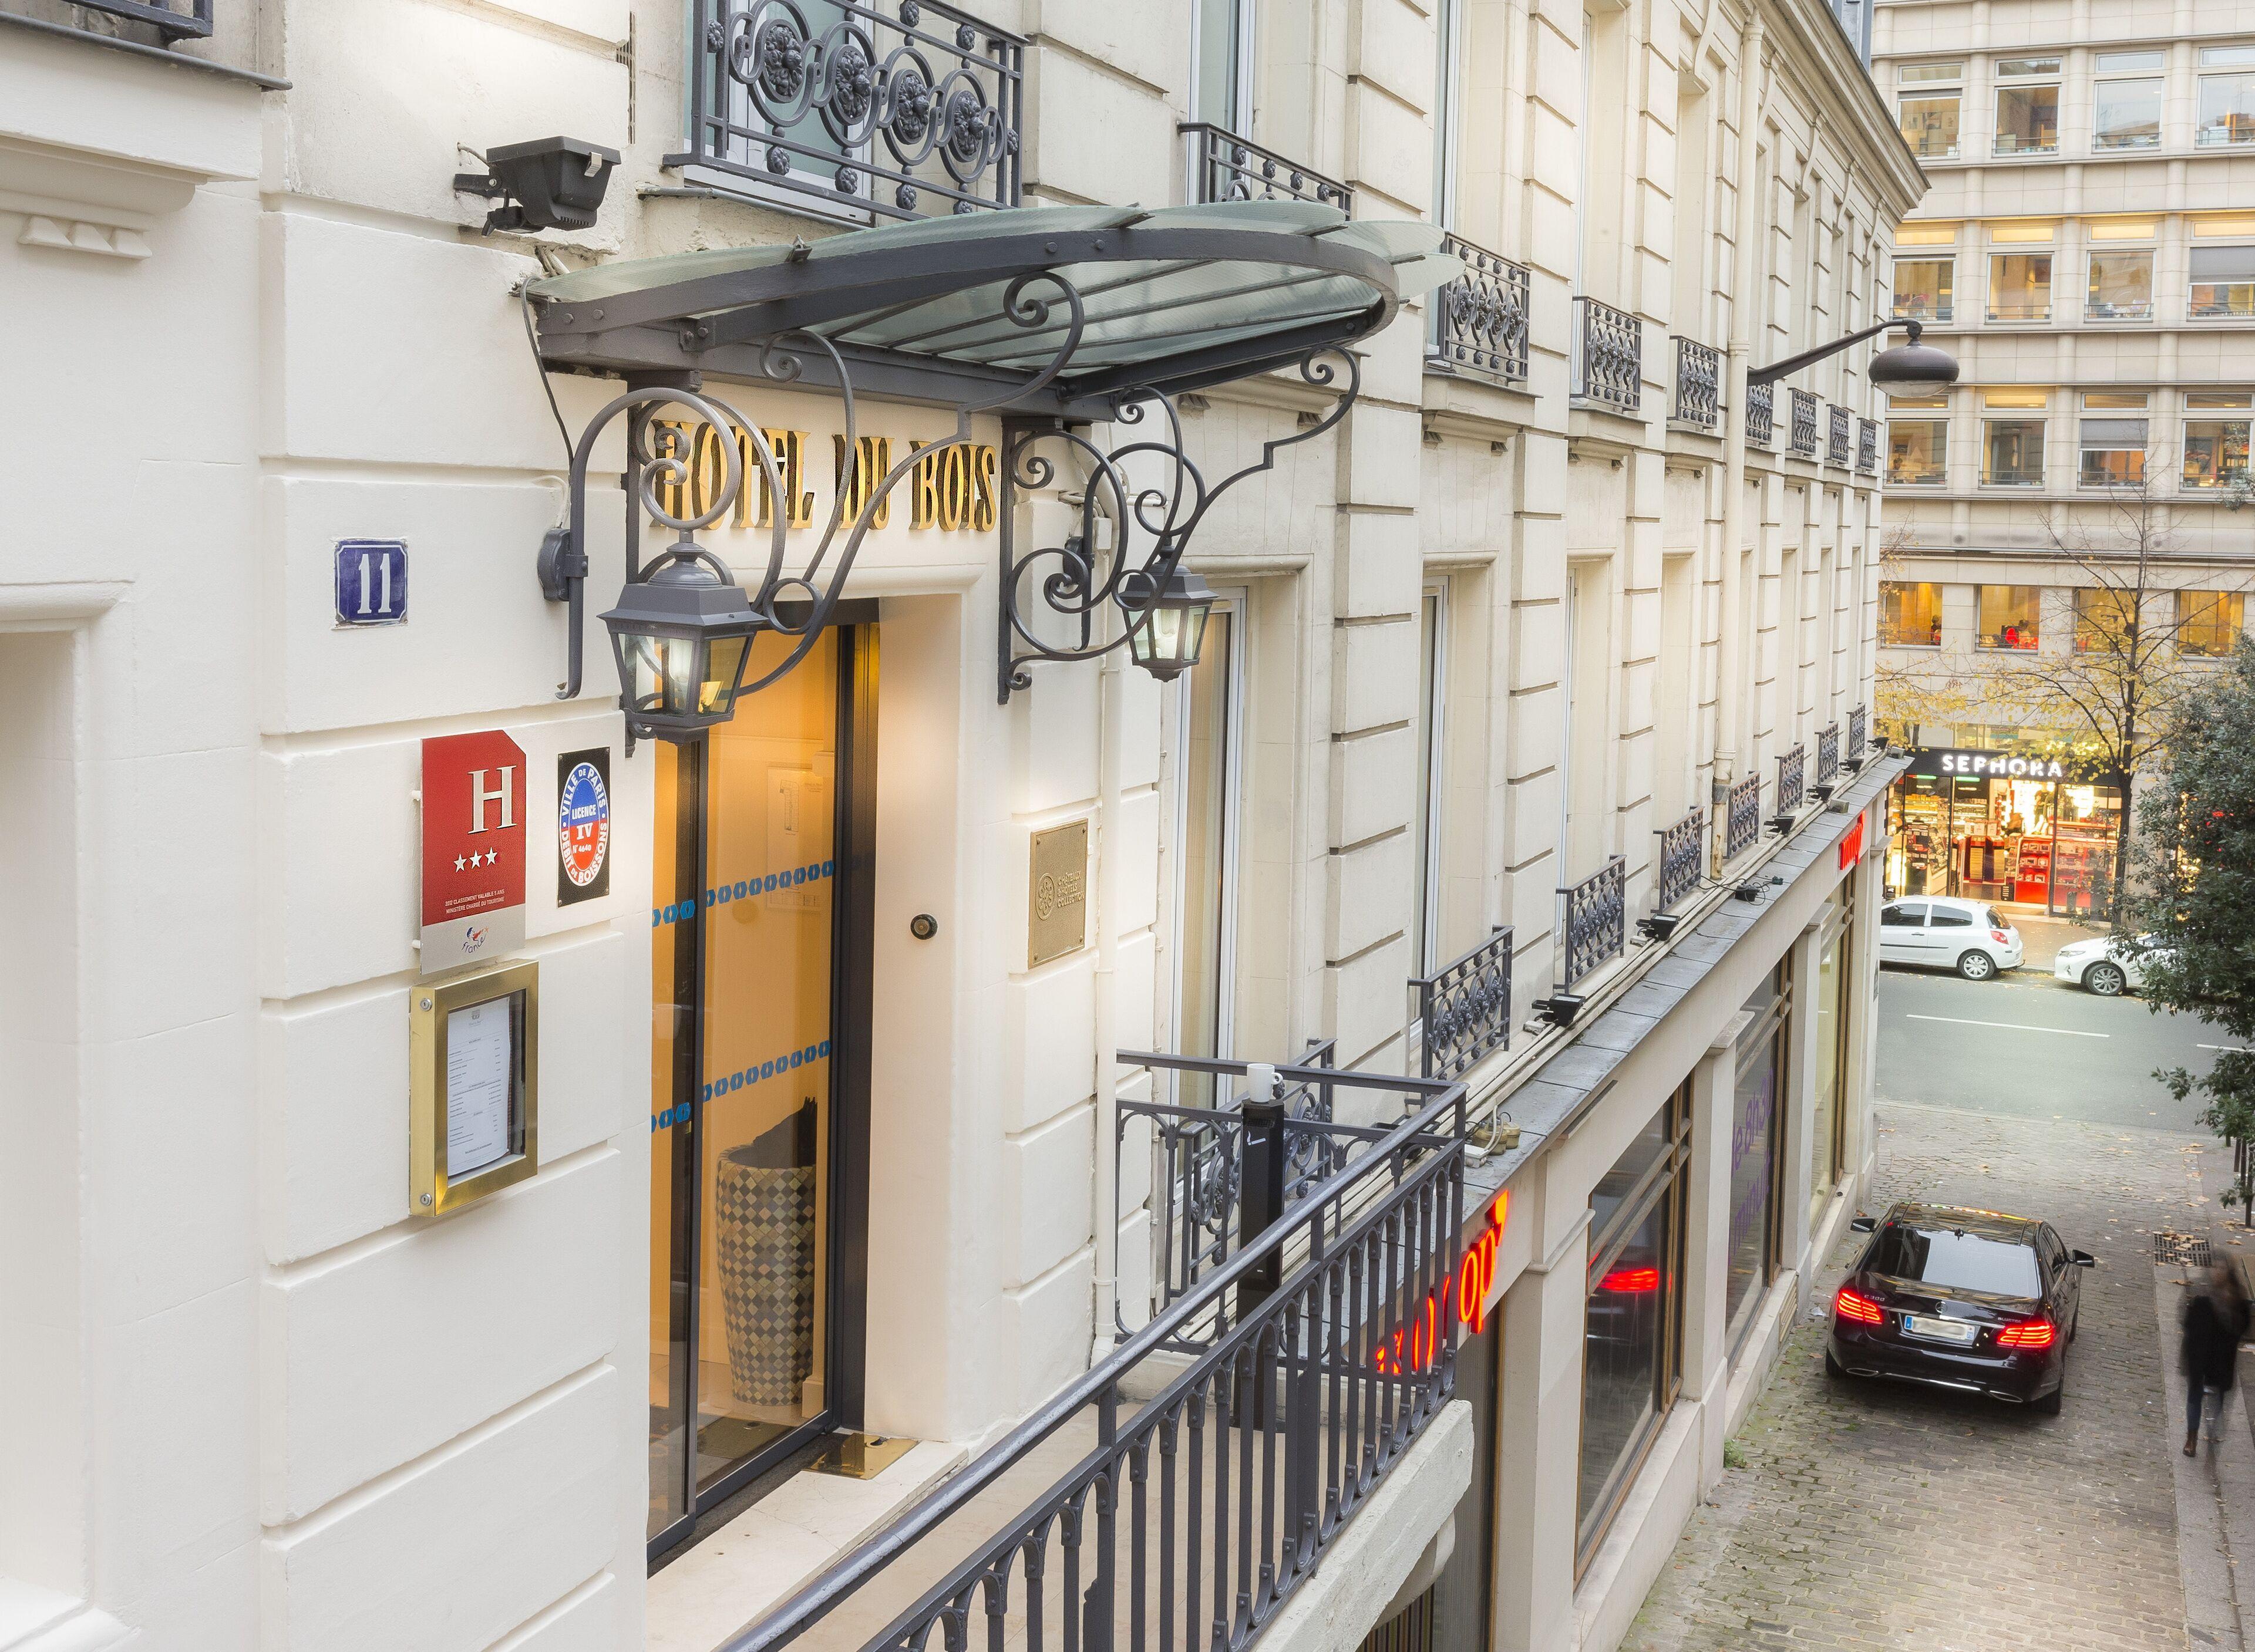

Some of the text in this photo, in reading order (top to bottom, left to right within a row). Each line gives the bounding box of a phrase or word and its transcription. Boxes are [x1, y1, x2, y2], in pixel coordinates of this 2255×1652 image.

[649, 419, 997, 531] HOTEL DU BOIS
[357, 553, 392, 614] 11
[1942, 755, 2062, 777] SEPHORA
[467, 765, 517, 834] H
[561, 768, 605, 817] VILLE DE PARIS
[571, 804, 597, 820] LICENCE
[576, 822, 593, 840] IV
[561, 822, 607, 884] DEBIT DE BOISSONS
[453, 895, 477, 905] CLASSEMENT
[487, 896, 505, 905] TOURISME
[1057, 891, 1085, 908] COLLECTION
[1745, 1067, 1773, 1155] 8h30
